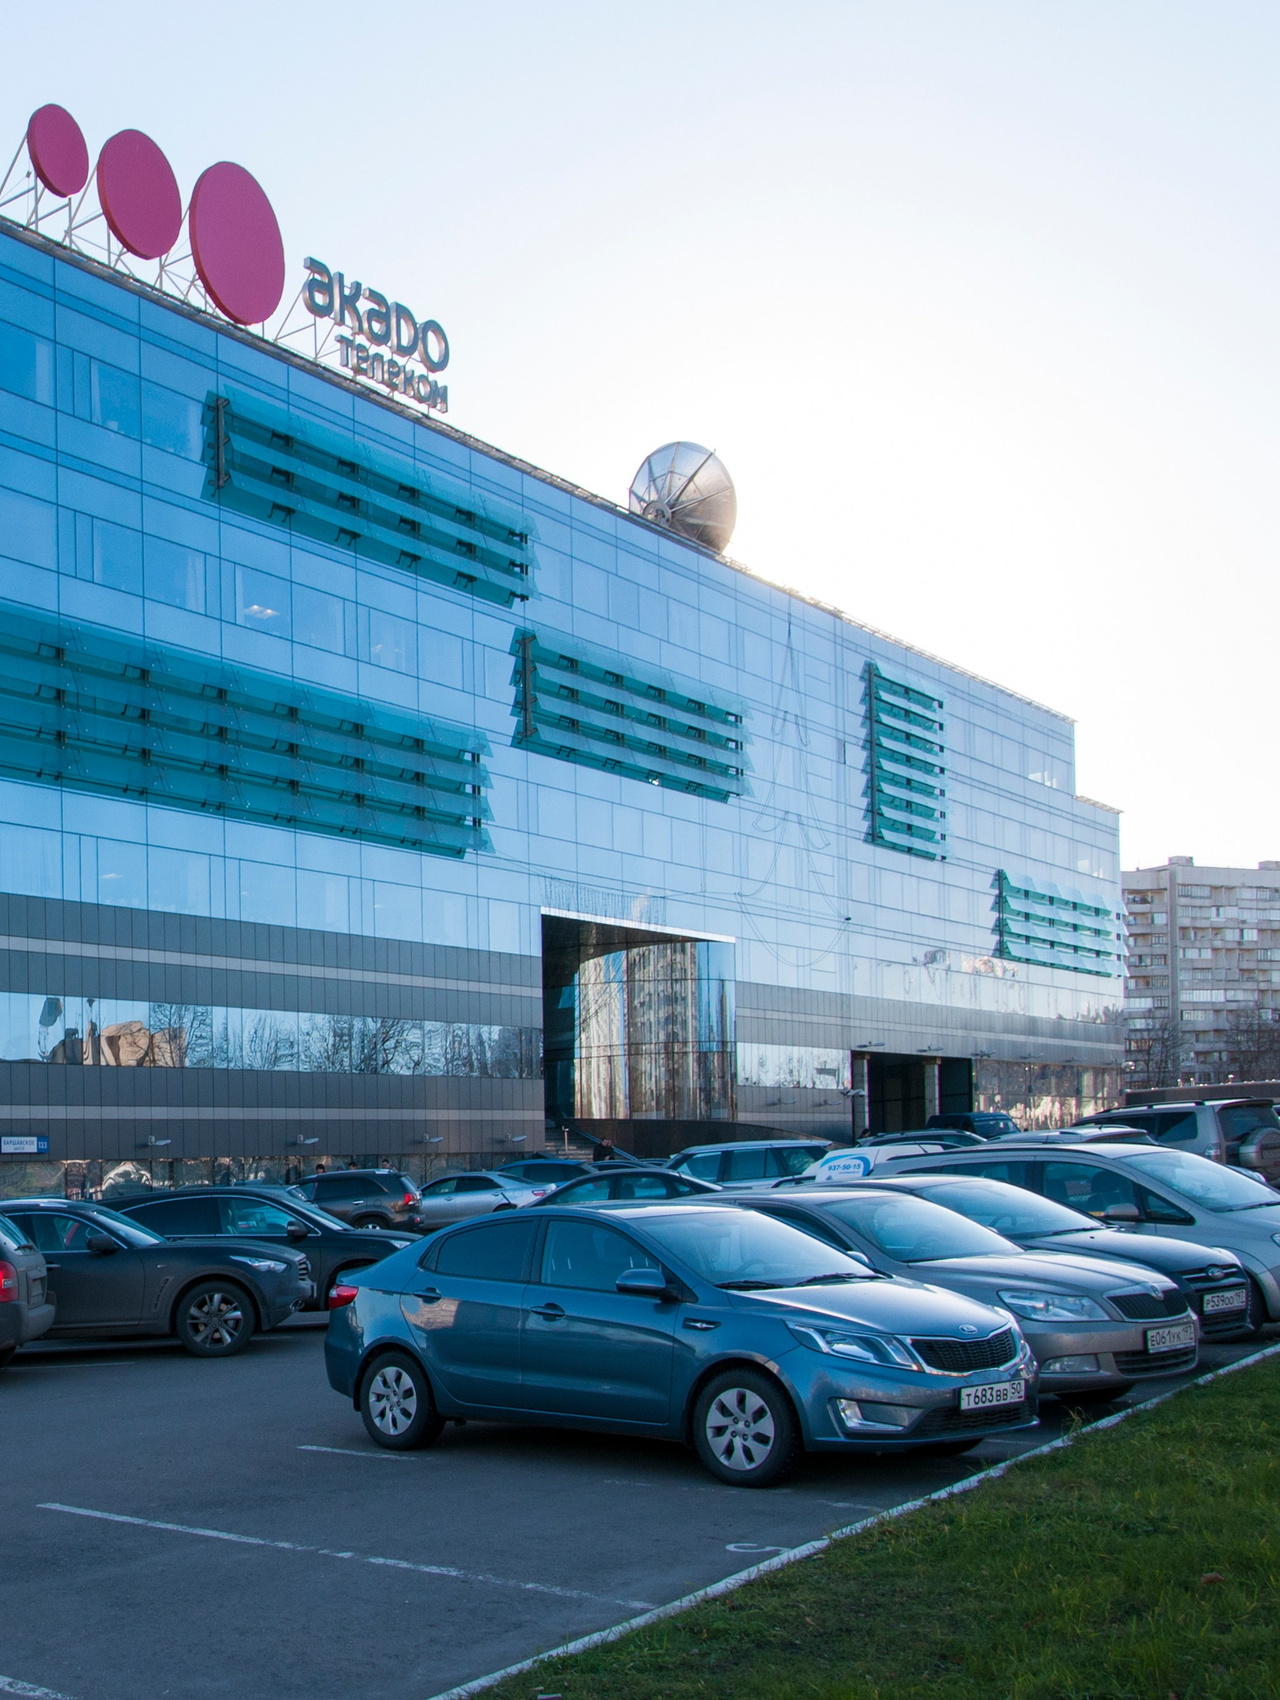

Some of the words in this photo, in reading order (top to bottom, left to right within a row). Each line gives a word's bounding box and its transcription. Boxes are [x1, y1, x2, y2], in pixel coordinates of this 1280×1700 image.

[38, 1141, 47, 1149] 133
[828, 1163, 861, 1171] 937-50-15
[965, 1386, 1008, 1406] Т683ВВ
[1010, 1382, 1022, 1395] 50
